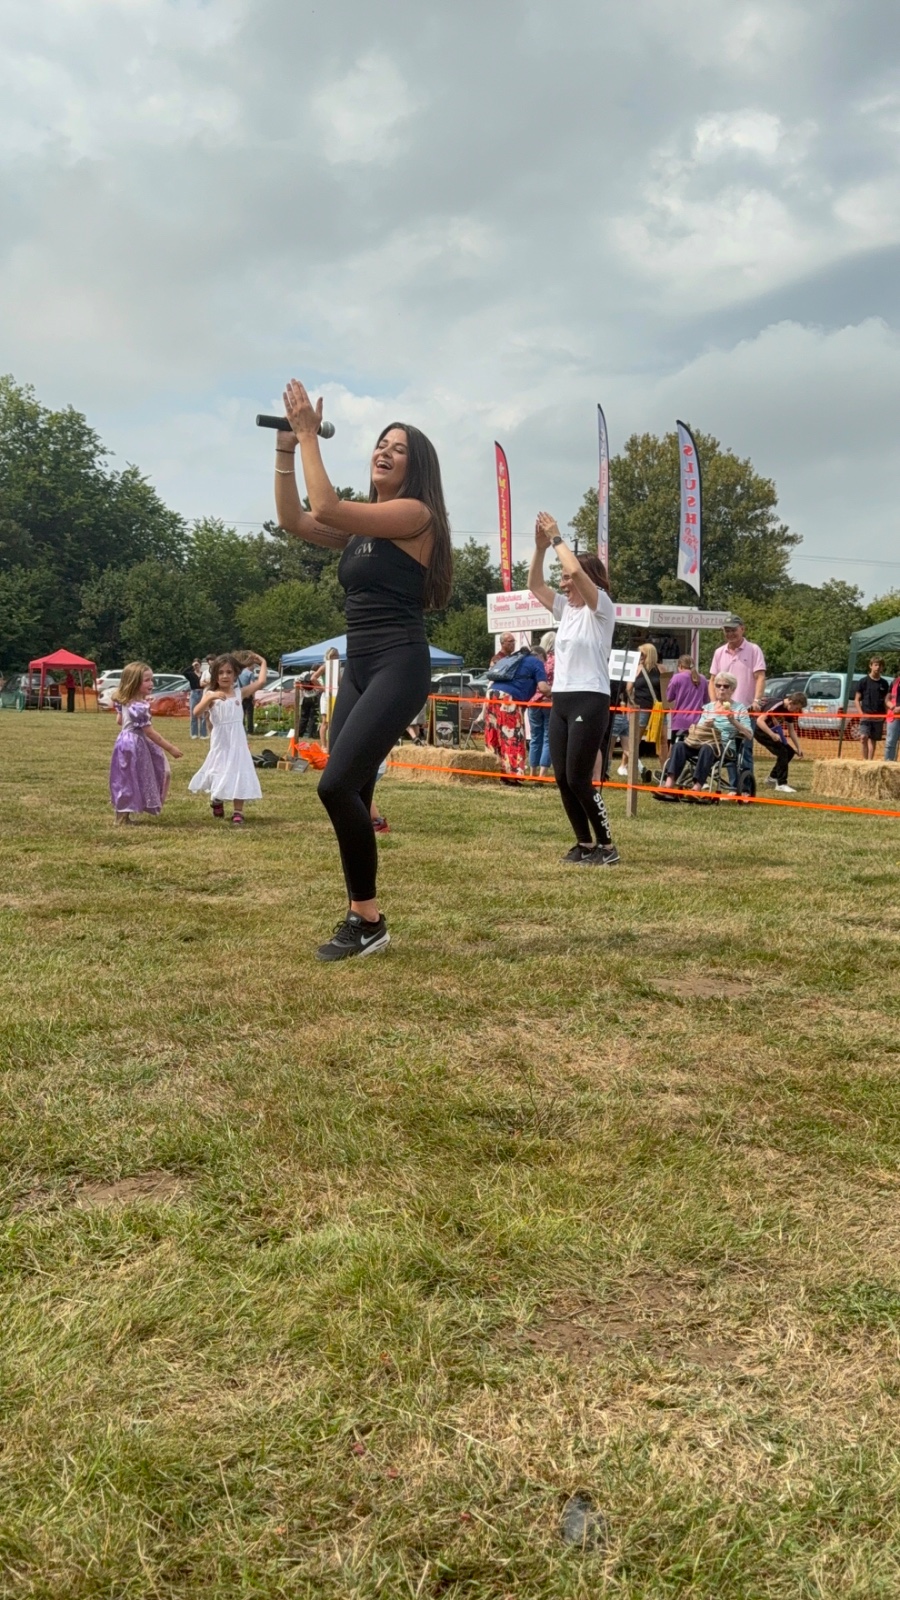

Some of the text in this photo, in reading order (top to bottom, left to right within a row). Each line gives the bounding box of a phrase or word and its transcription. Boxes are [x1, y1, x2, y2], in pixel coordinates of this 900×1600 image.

[494, 619, 515, 629] Sweet
[657, 613, 685, 624] Sweet
[593, 792, 612, 839] adidas
